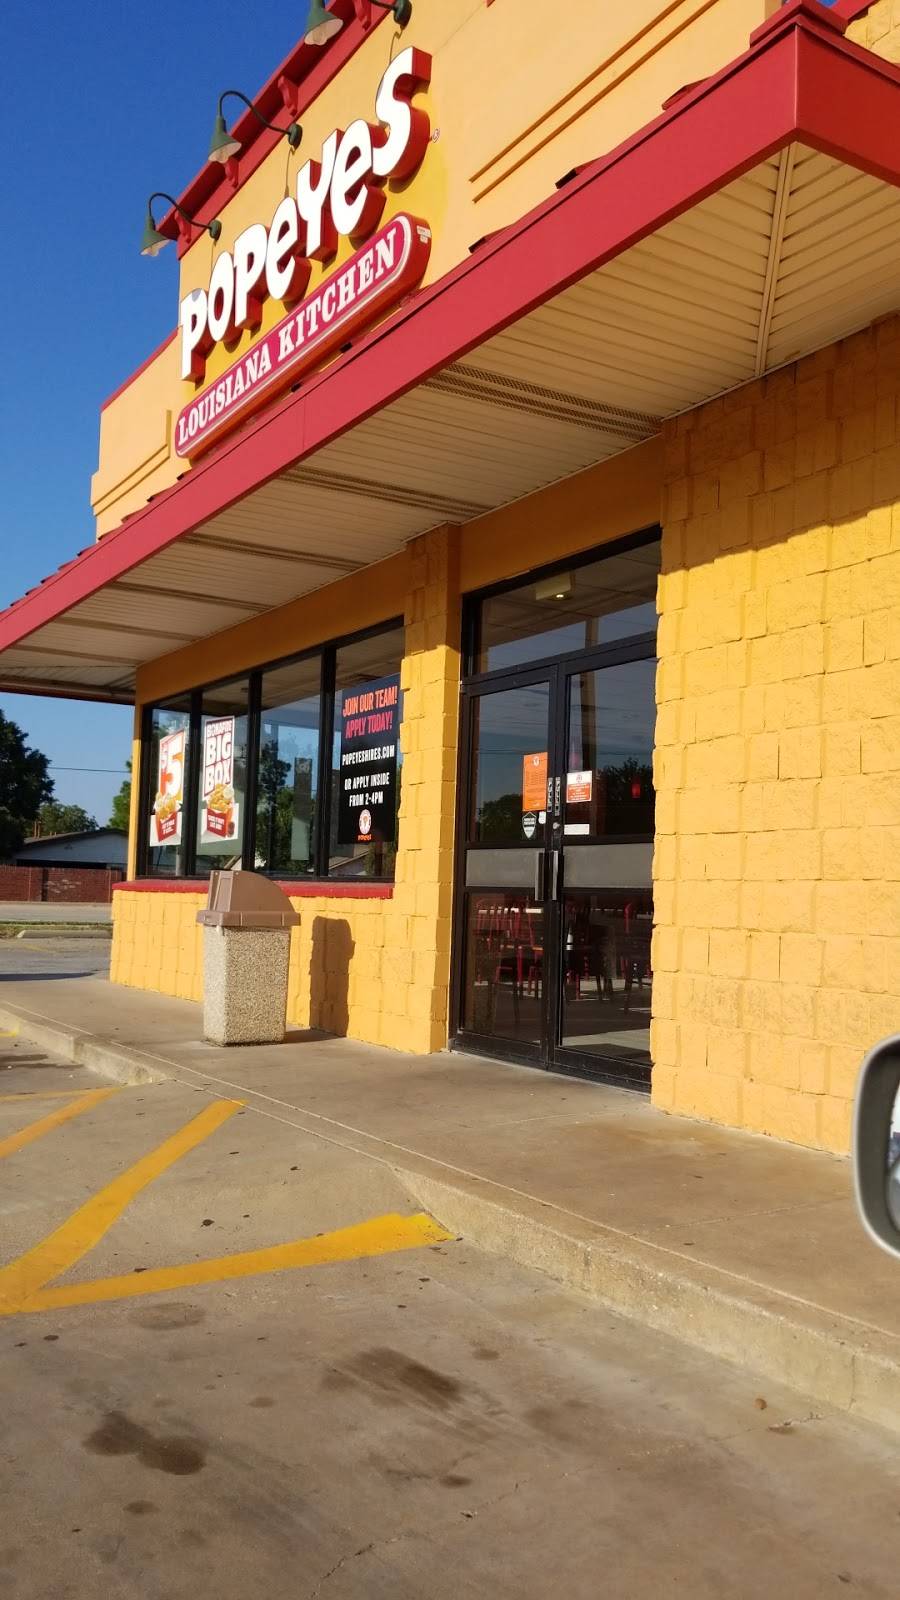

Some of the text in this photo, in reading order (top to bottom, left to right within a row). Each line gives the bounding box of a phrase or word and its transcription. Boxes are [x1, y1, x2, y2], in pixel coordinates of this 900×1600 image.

[178, 227, 399, 446] LOUISIANA KITCHEN
[342, 685, 398, 717] JOIN OUR TEAM!
[345, 711, 393, 739] APPLY TODAY!
[206, 732, 232, 766] BIG
[341, 745, 395, 766] POPEYESHIRES.COM
[205, 758, 231, 795] BOX
[344, 772, 390, 791] OR APPLY INSIDE
[349, 791, 384, 807] FROM 2-4PM
